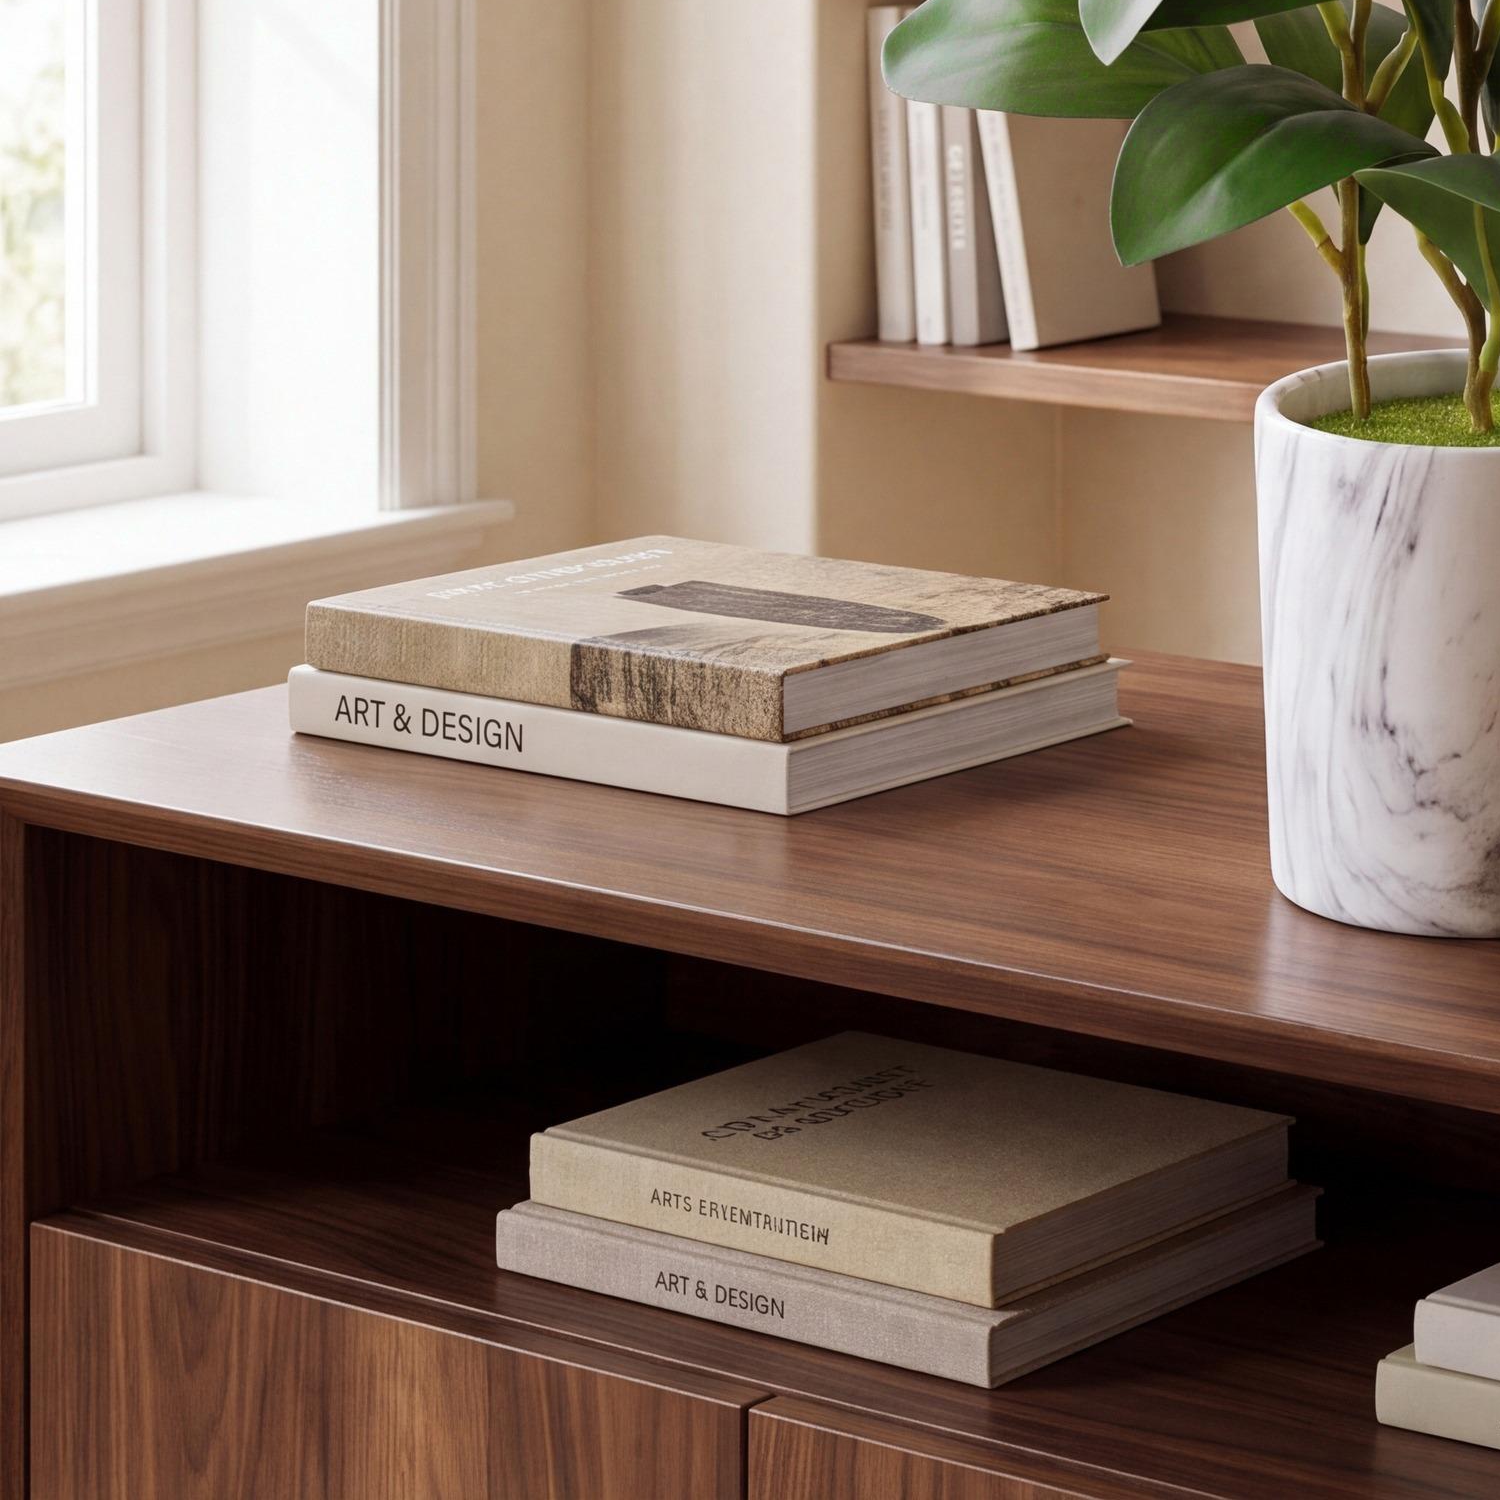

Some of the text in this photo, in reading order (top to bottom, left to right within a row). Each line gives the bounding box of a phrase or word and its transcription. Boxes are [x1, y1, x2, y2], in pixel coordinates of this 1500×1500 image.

[335, 695, 523, 752] ART & DESIGN
[650, 1188, 693, 1213] ARTS
[655, 1270, 786, 1320] ART & DESIGN
